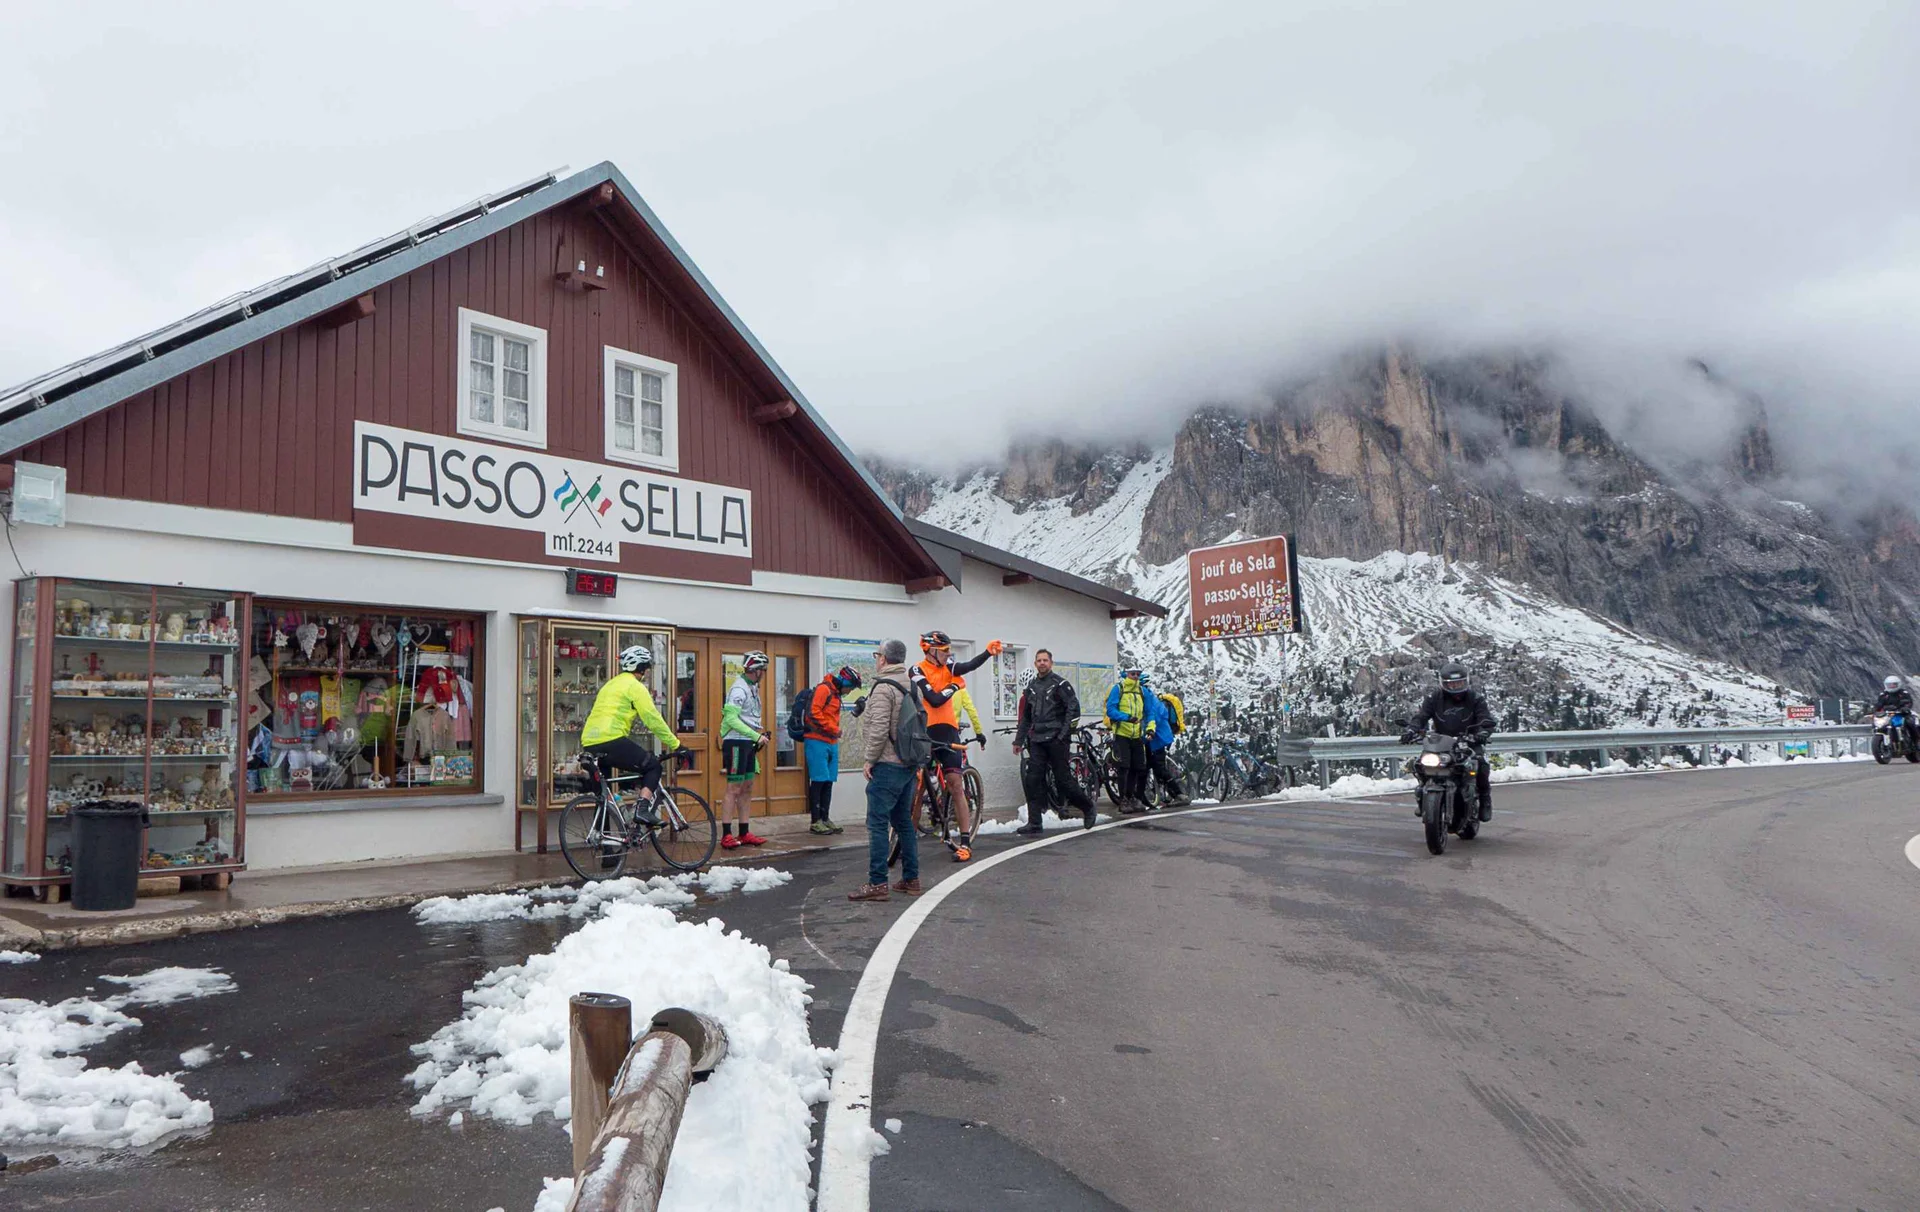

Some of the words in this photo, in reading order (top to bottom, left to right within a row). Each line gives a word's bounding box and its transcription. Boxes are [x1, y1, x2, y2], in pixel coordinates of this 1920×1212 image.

[361, 434, 546, 519] PASSO
[619, 478, 748, 548] SELLA
[553, 532, 614, 557] mt.2244
[1201, 559, 1225, 581] jouf
[1229, 558, 1244, 575] de
[1247, 554, 1276, 572] Sela
[1210, 613, 1232, 627] 2240
